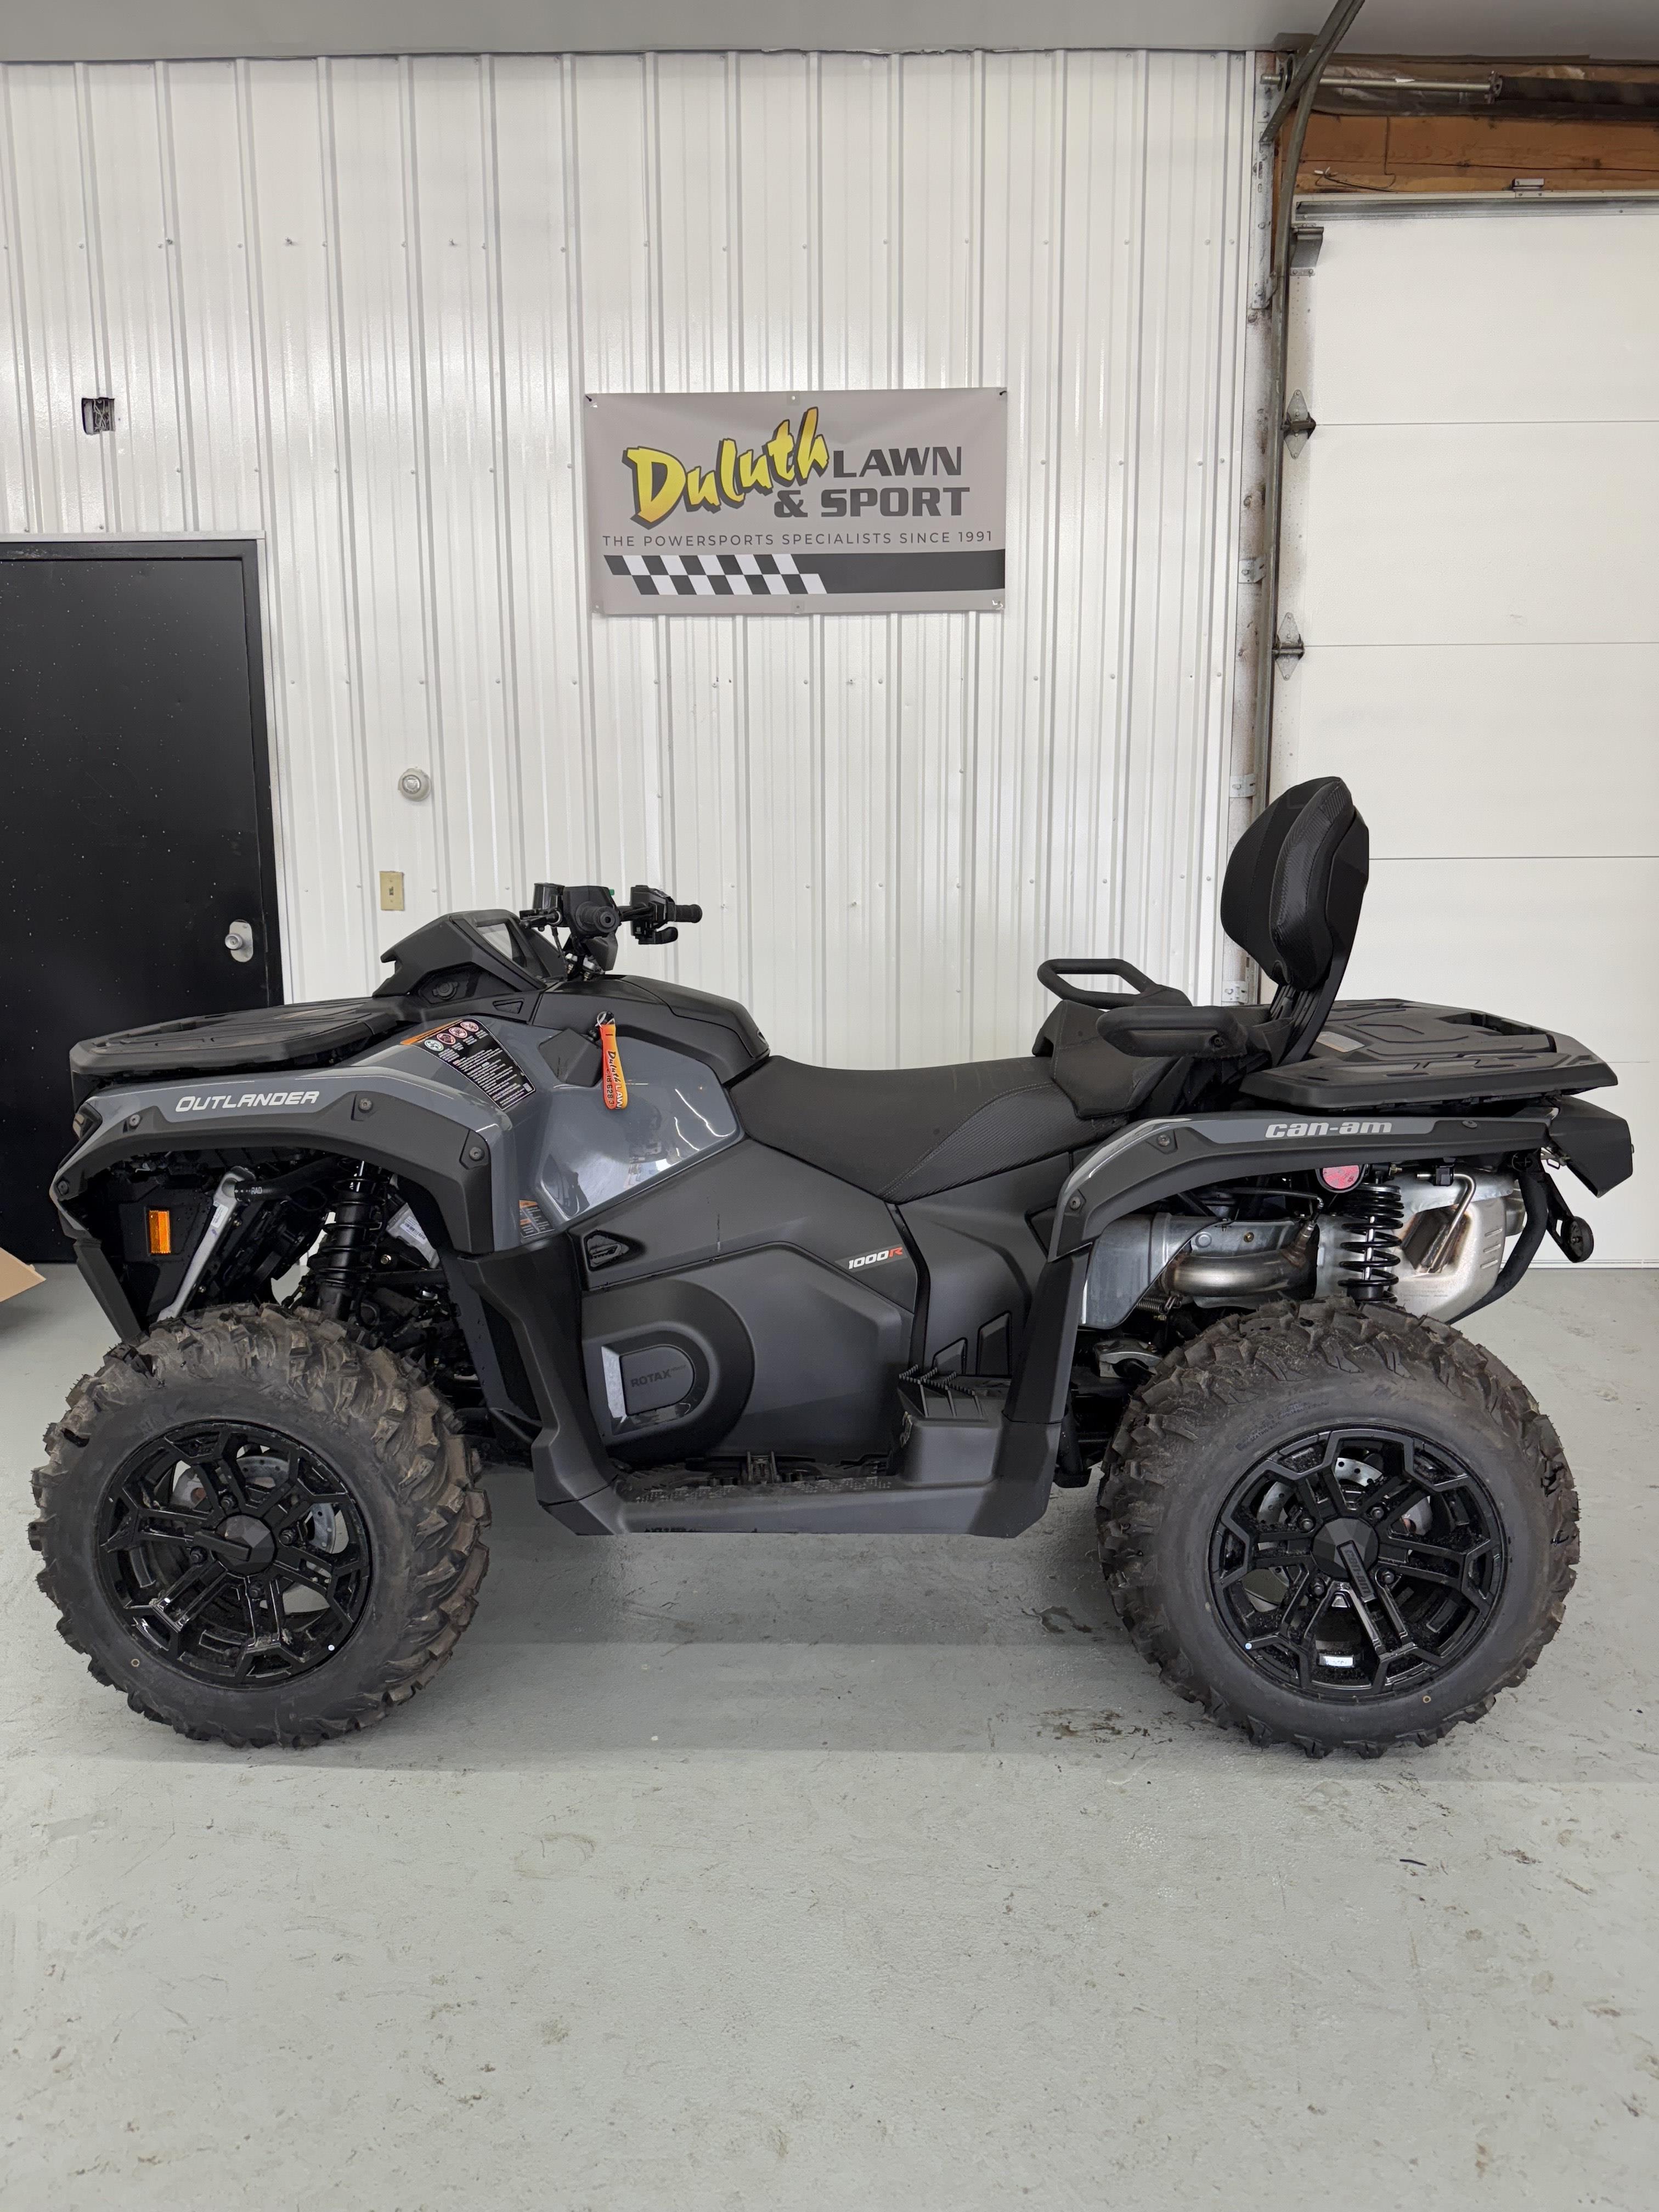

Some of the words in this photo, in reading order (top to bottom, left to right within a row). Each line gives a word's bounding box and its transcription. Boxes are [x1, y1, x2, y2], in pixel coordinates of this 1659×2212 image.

[622, 407, 830, 529] Duluth
[833, 446, 962, 478] LAWN
[774, 492, 808, 518] &
[821, 487, 970, 517] SPORT
[603, 535, 634, 546] THE
[644, 534, 774, 546] POWERSPORTS
[782, 533, 891, 544] SPECIALISTS
[899, 532, 950, 544] SINCE
[958, 531, 991, 542] 1991
[608, 1050, 621, 1082] Duluth
[616, 1085, 624, 1110] LAW
[176, 1091, 319, 1112] OUTLANDER
[1265, 1121, 1392, 1138] can-am
[848, 1246, 903, 1269] 1000R
[630, 1369, 672, 1387] ROTAX
